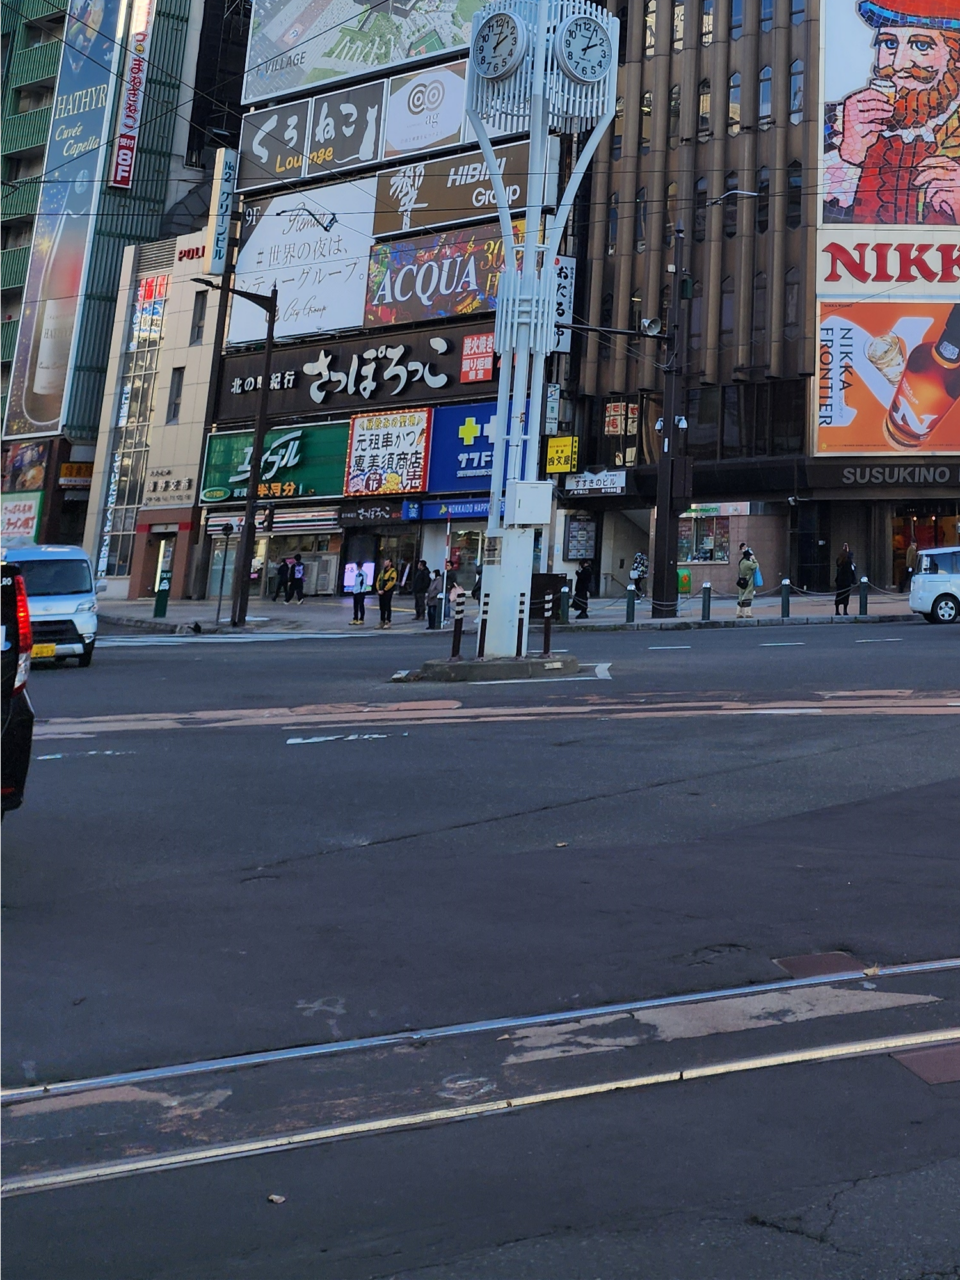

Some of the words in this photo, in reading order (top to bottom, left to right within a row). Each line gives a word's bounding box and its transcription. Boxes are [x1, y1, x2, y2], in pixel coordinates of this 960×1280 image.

[264, 52, 306, 75] VILLAGE
[55, 84, 107, 119] HATHYR
[55, 122, 83, 140] Cuvée
[118, 137, 135, 148] 受付
[63, 137, 100, 157] Capella
[117, 150, 132, 181] 8F
[275, 147, 333, 173] Lounge
[447, 157, 507, 187] HIBII
[213, 191, 233, 261] グリーンビル
[245, 207, 261, 227] 9F
[372, 255, 478, 306] ACQUA
[303, 337, 448, 404] さっぽろっこ
[839, 328, 853, 391] NIKKA
[819, 328, 834, 426] FRONTIER
[355, 431, 416, 452] 元祖串かつ
[353, 450, 422, 472] 恵美須商店
[575, 477, 617, 488] すすきのビル
[842, 467, 951, 484] SUSUKINO
